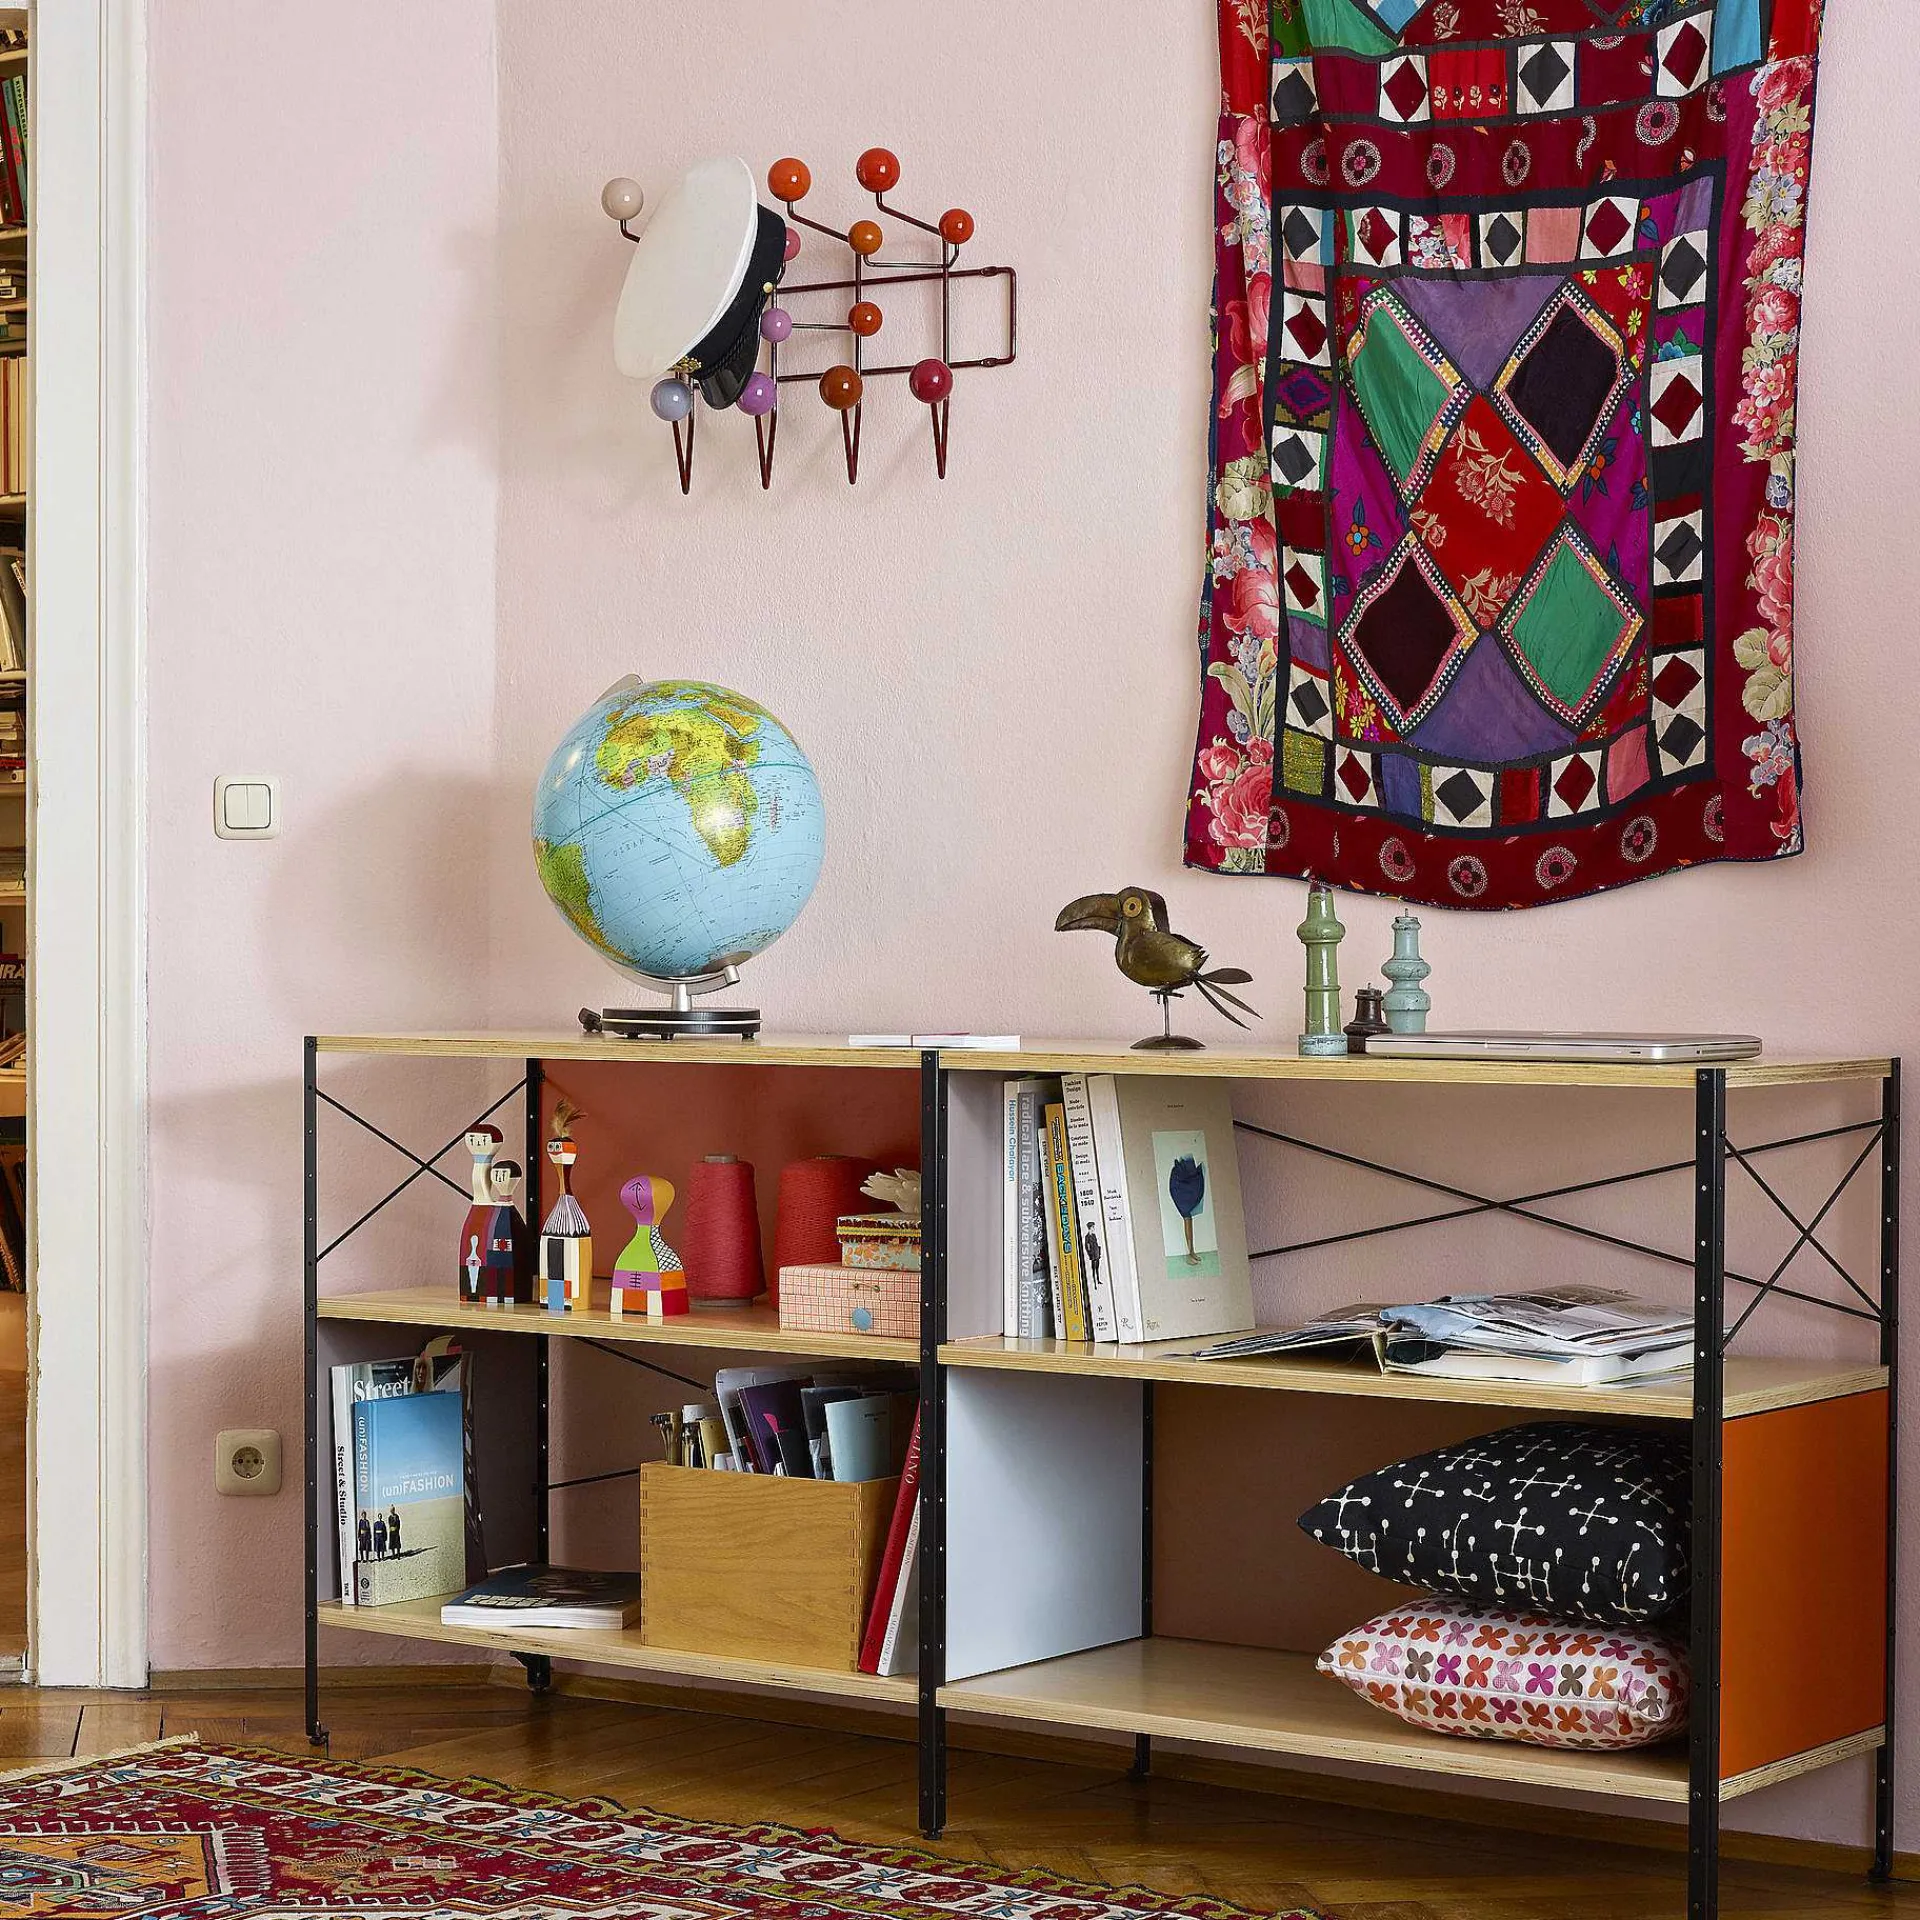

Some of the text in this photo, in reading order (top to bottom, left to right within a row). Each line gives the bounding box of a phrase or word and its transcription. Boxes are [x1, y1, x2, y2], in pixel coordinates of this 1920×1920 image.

[1009, 1099, 1017, 1182] Hussein Chalayan
[1056, 1163, 1068, 1203] BACK
[1020, 1096, 1032, 1337] radical lace & subversive knitting
[354, 1375, 411, 1403] Street
[337, 1445, 346, 1477] Street
[358, 1416, 369, 1493] (un)FASHION
[338, 1479, 346, 1488] &
[382, 1473, 455, 1498] (un)FASHION
[339, 1490, 348, 1525] Studio
